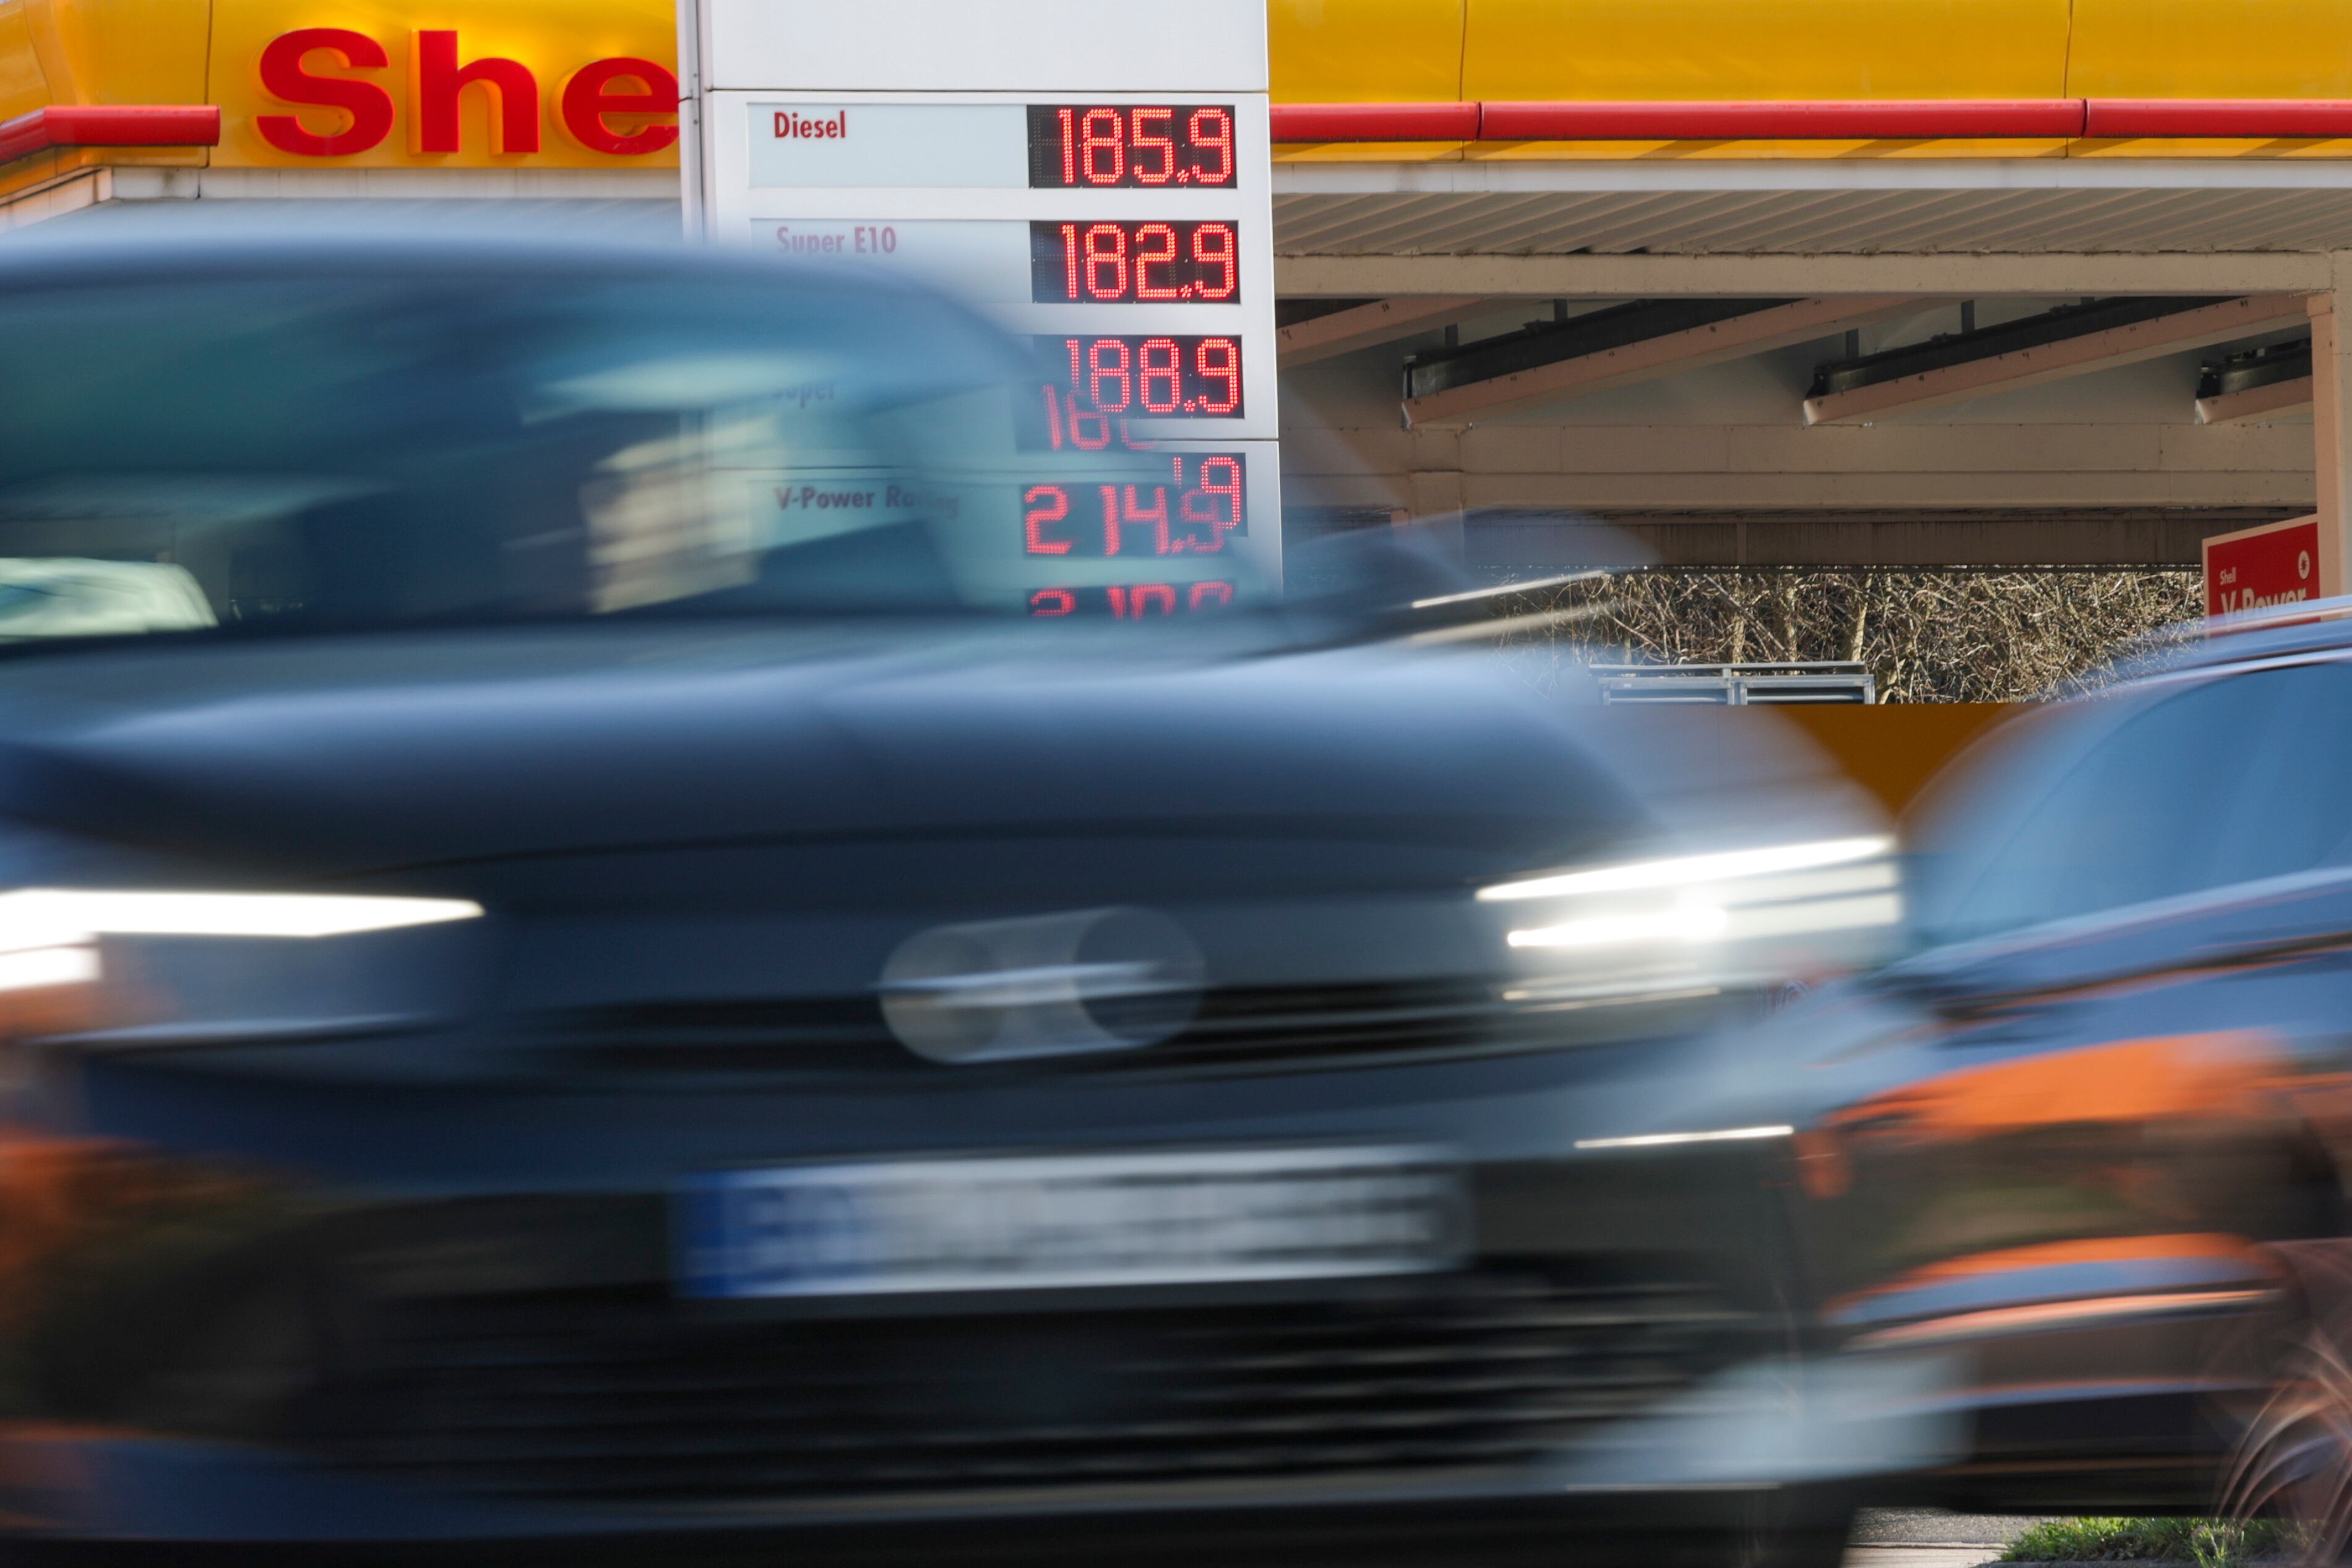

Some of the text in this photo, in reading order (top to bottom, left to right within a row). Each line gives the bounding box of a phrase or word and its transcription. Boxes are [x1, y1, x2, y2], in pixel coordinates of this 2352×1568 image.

[774, 108, 1231, 184] Diesel 185.9
[777, 223, 1234, 299] Super E10 182.9
[1066, 338, 1238, 413] 188.9
[775, 486, 875, 510] V-Power
[2220, 567, 2236, 585] Shell
